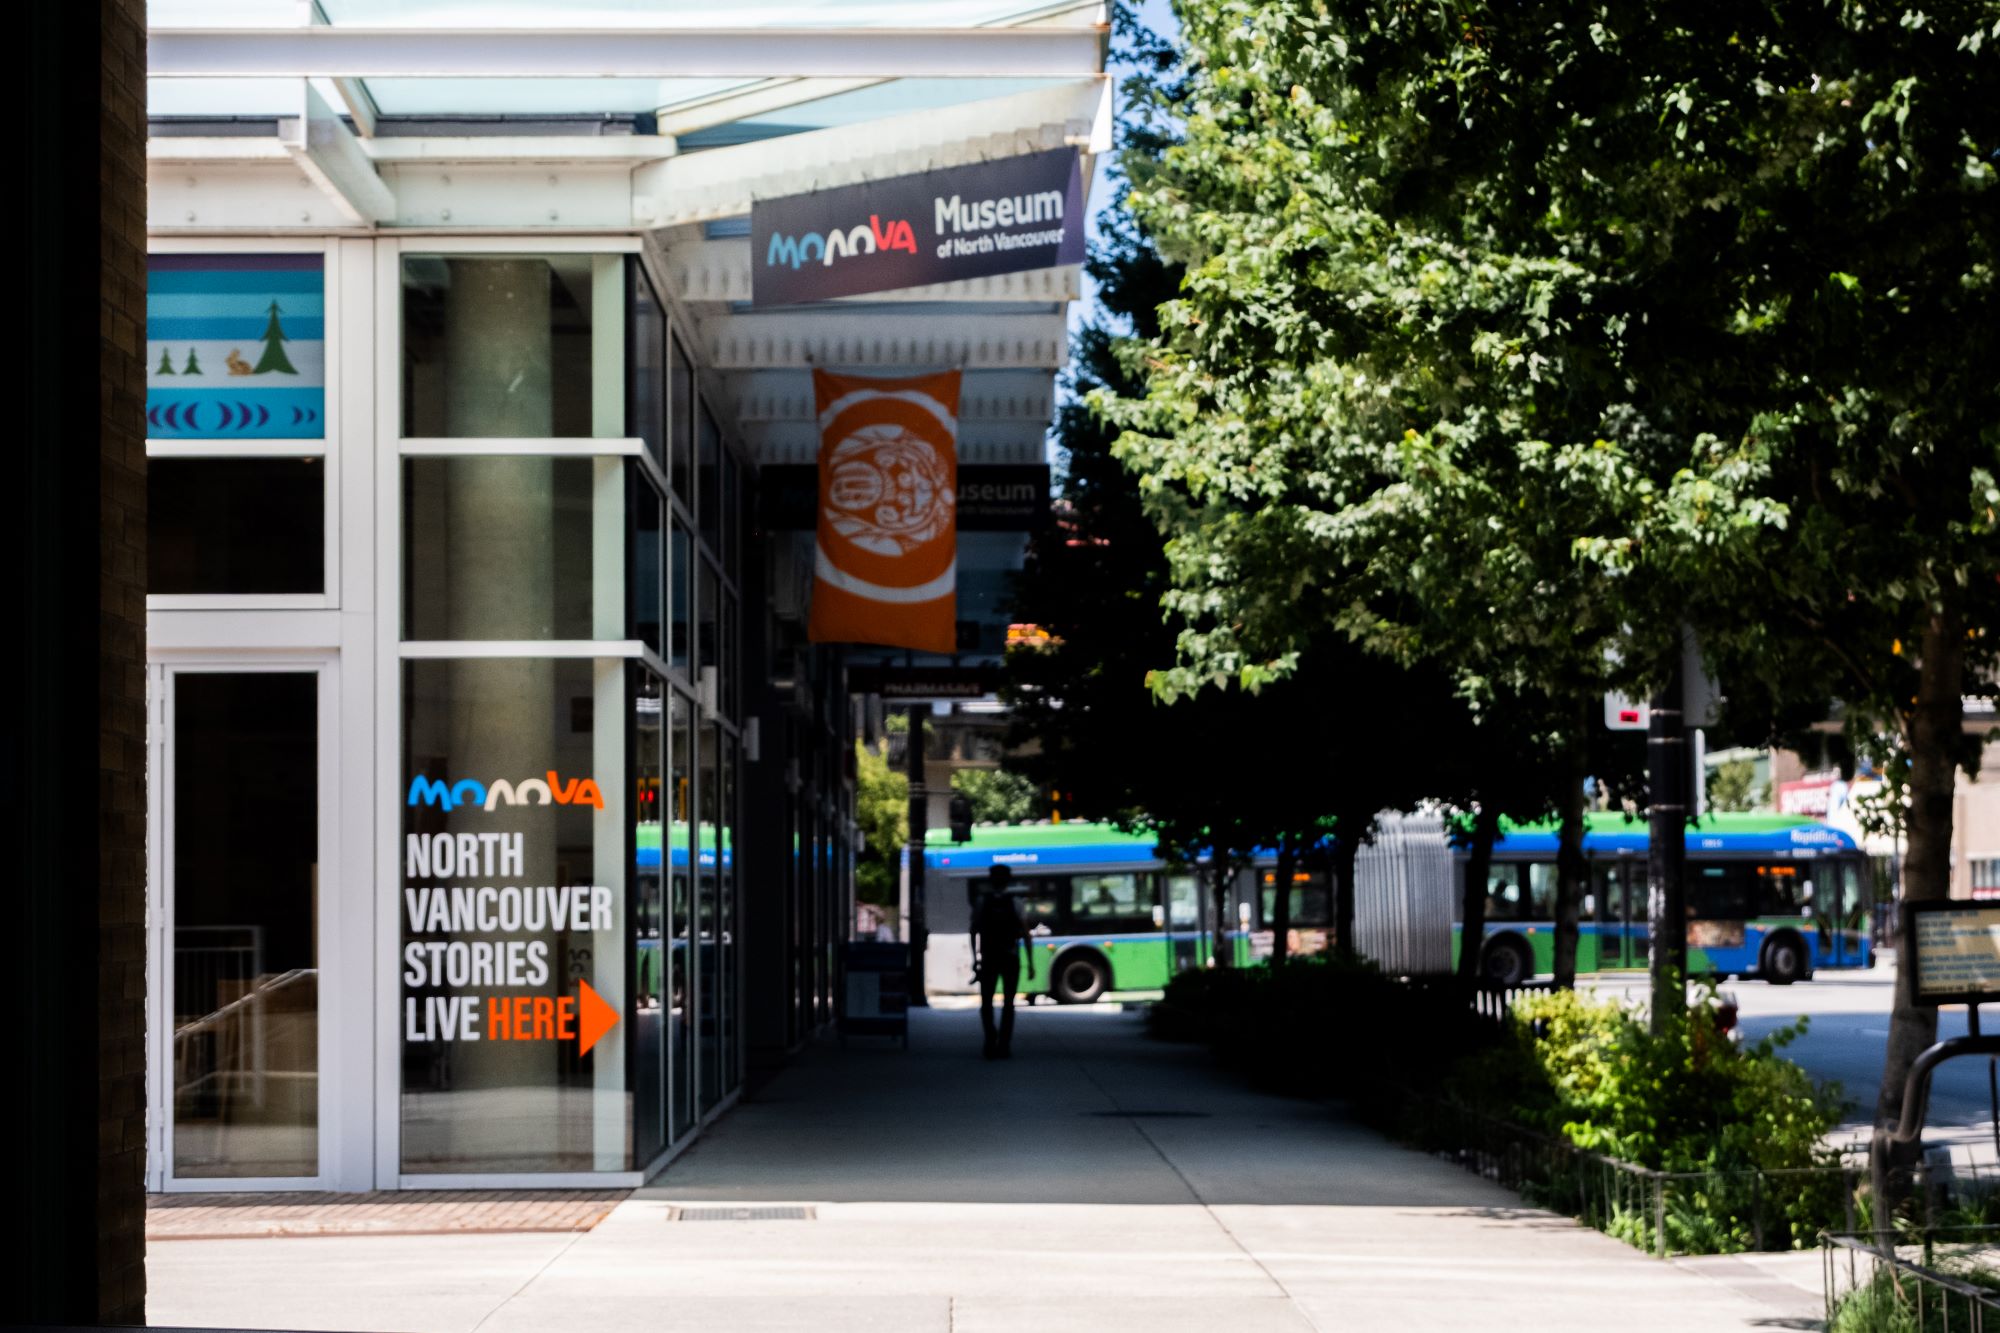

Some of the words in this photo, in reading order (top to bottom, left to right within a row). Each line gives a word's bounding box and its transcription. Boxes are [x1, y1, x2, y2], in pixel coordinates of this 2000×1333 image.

[933, 190, 1063, 235] Museum
[936, 238, 953, 259] of
[953, 236, 994, 256] North
[993, 227, 1066, 251] Vancouver
[957, 483, 1036, 501] useum
[406, 832, 524, 878] NORTH
[405, 886, 613, 932] VANCOUVER
[404, 941, 549, 987] STORIES
[406, 996, 480, 1041] LIVE
[487, 996, 575, 1041] HERE
